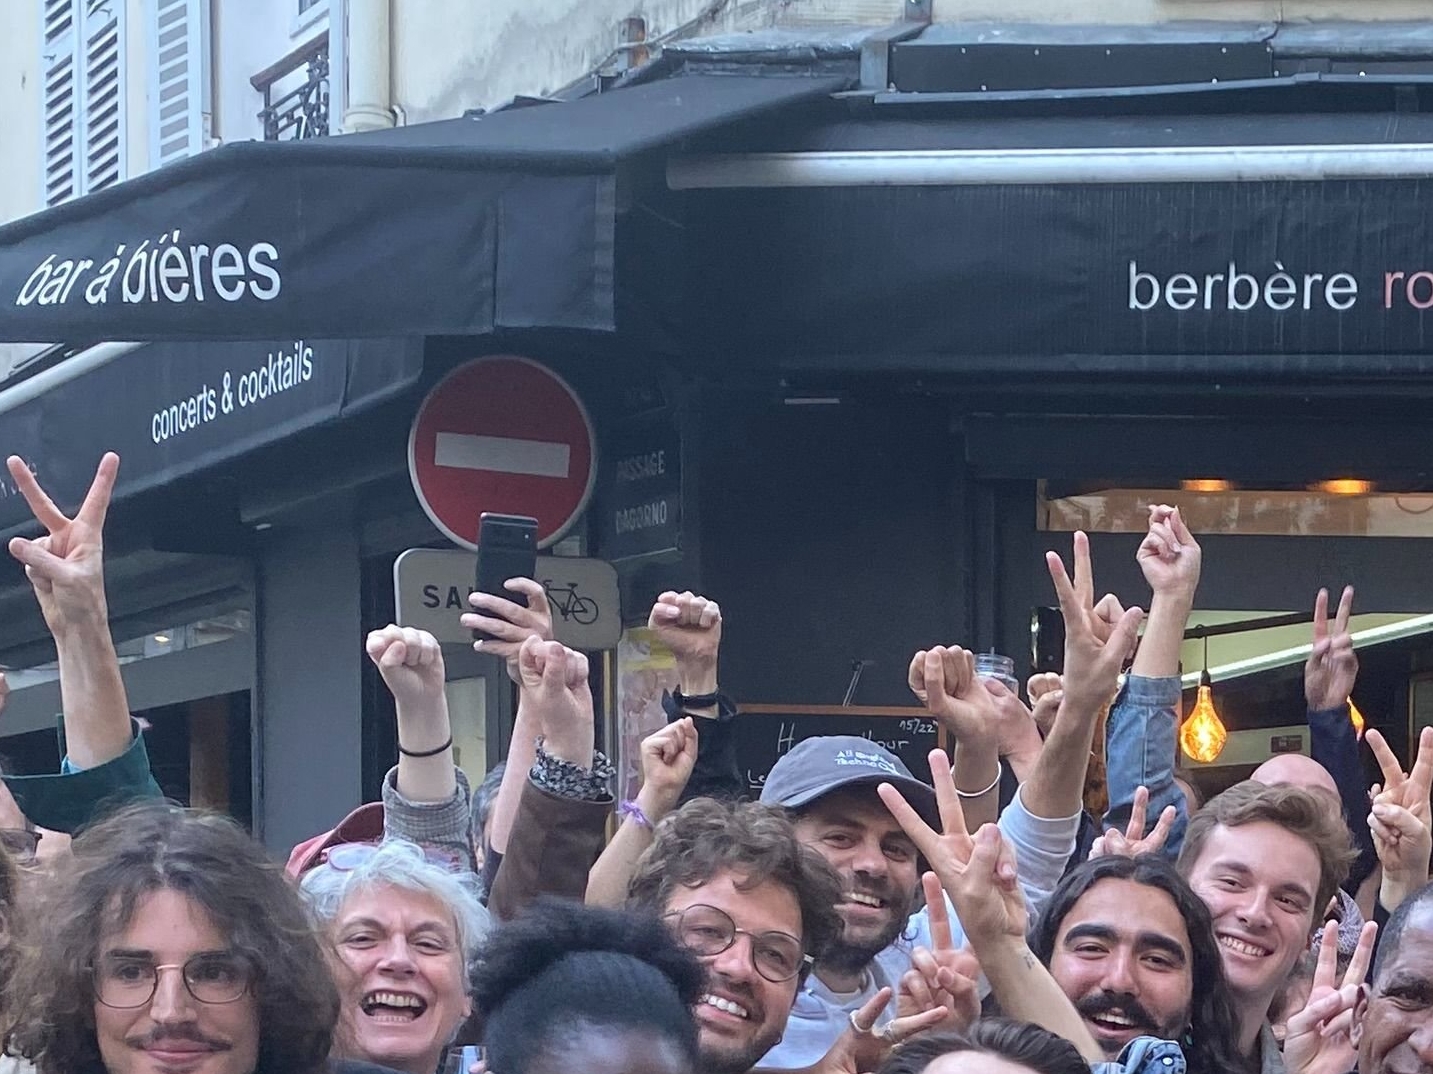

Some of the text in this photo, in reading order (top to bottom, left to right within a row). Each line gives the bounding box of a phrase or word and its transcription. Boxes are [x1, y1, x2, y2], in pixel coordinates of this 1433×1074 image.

[16, 254, 93, 305] bar
[1129, 261, 1358, 310] berbère
[152, 340, 313, 444] concerts & cocktails
